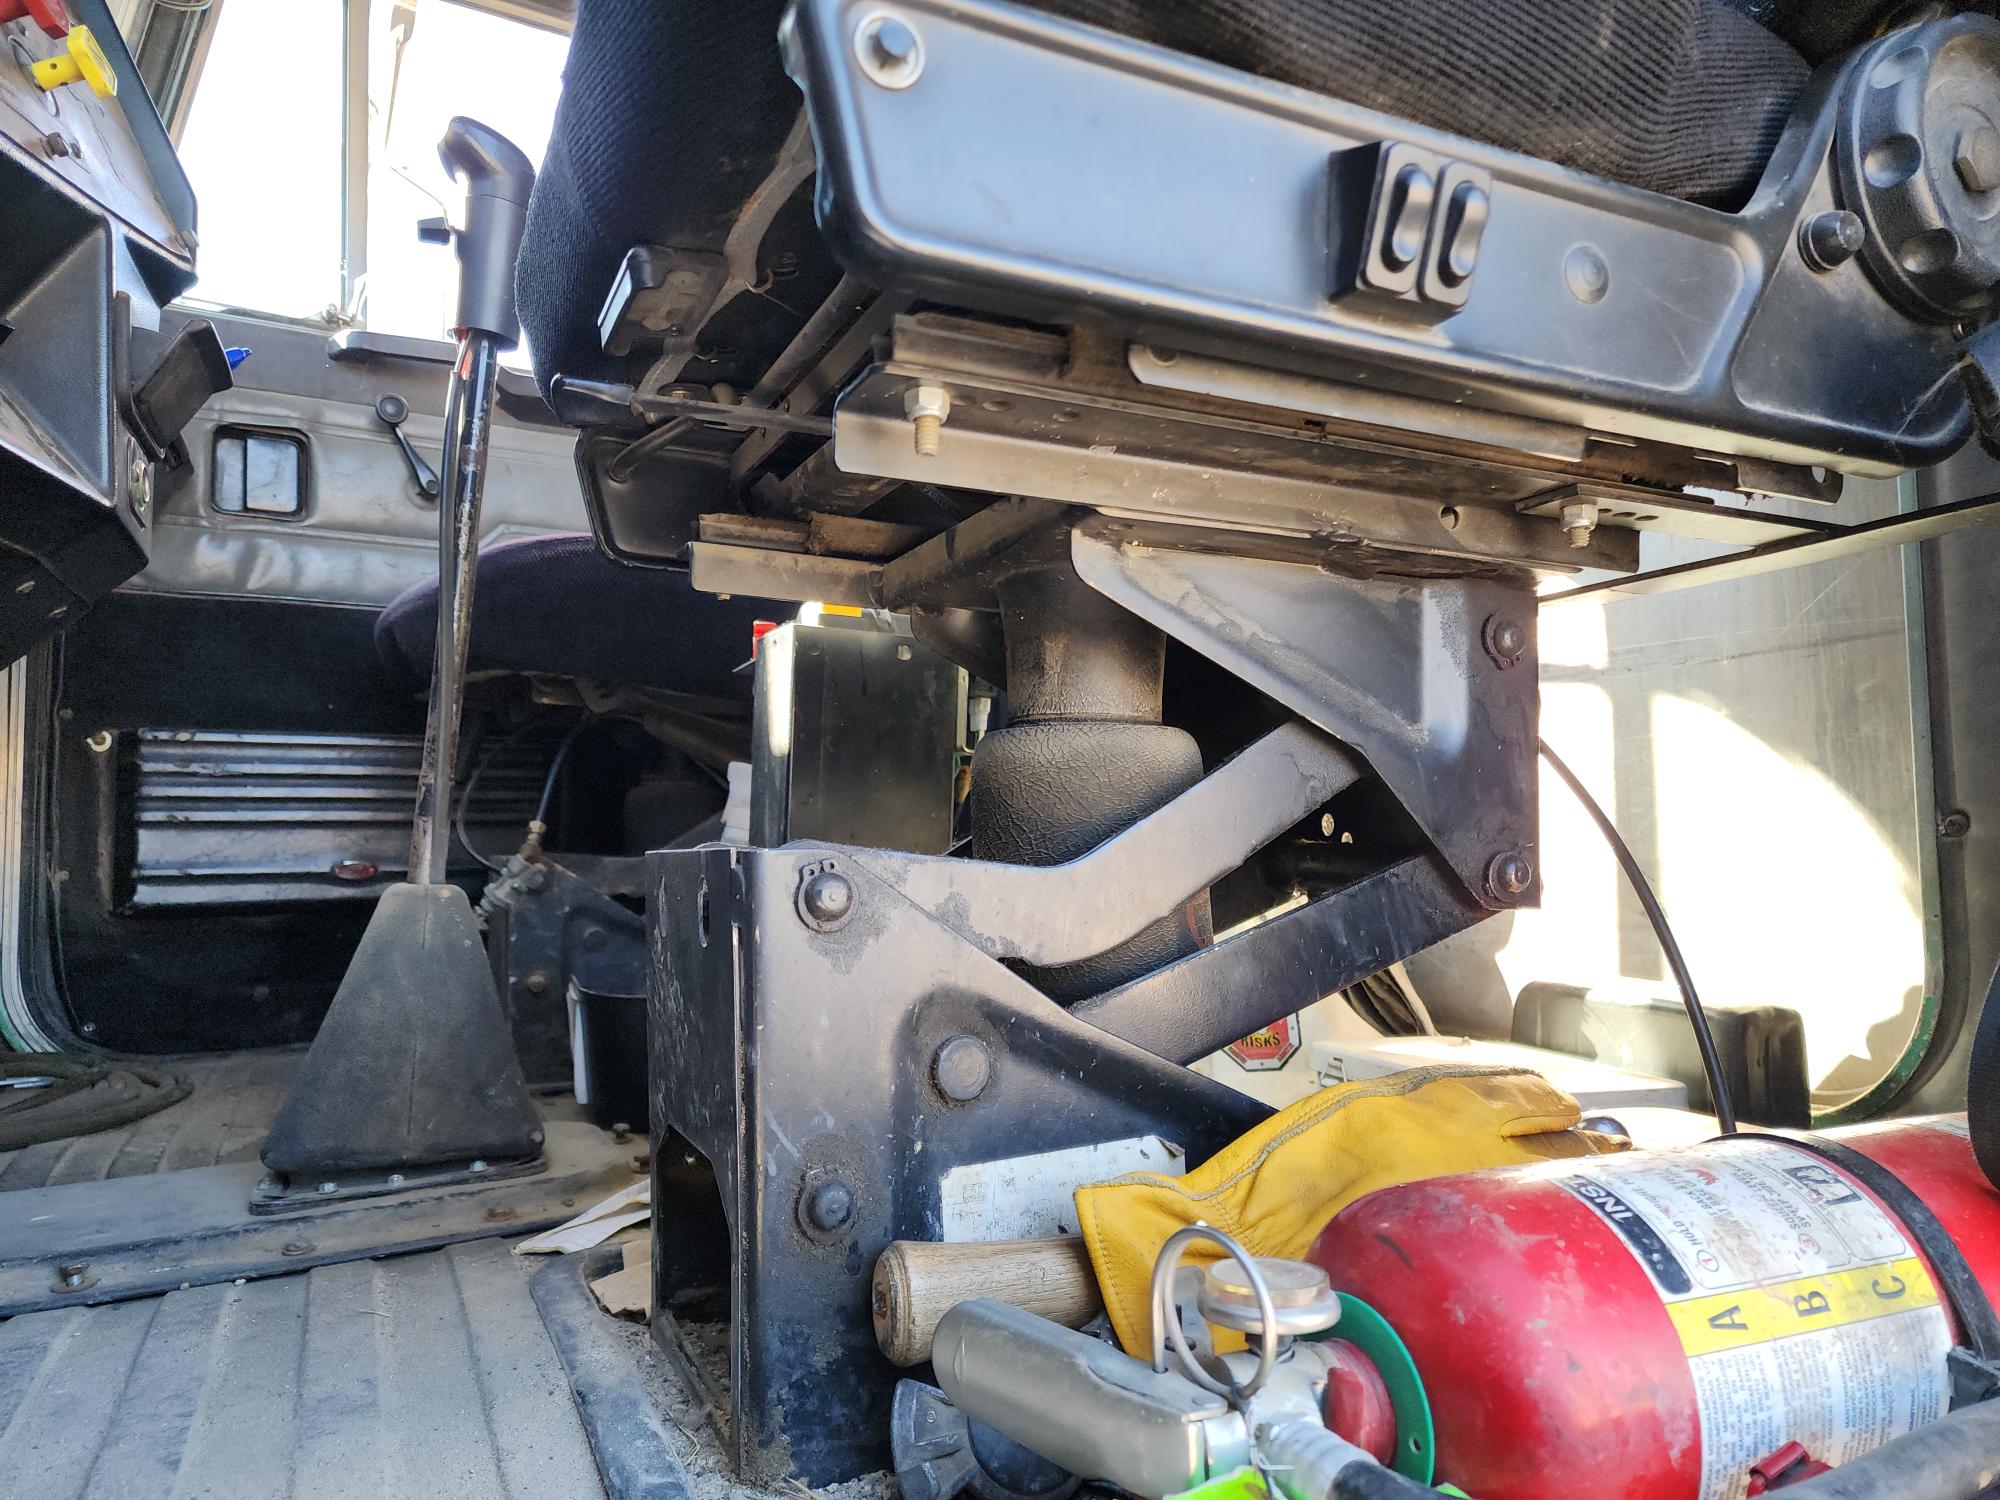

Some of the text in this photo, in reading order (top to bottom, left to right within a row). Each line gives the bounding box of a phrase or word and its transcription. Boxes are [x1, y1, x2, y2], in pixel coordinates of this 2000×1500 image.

[1241, 1032, 1280, 1048] RISKS
[1669, 1220, 1703, 1246] HOLD
[1872, 1275, 1906, 1300] C
[1793, 1290, 1831, 1318] B
[1707, 1304, 1749, 1331] A
